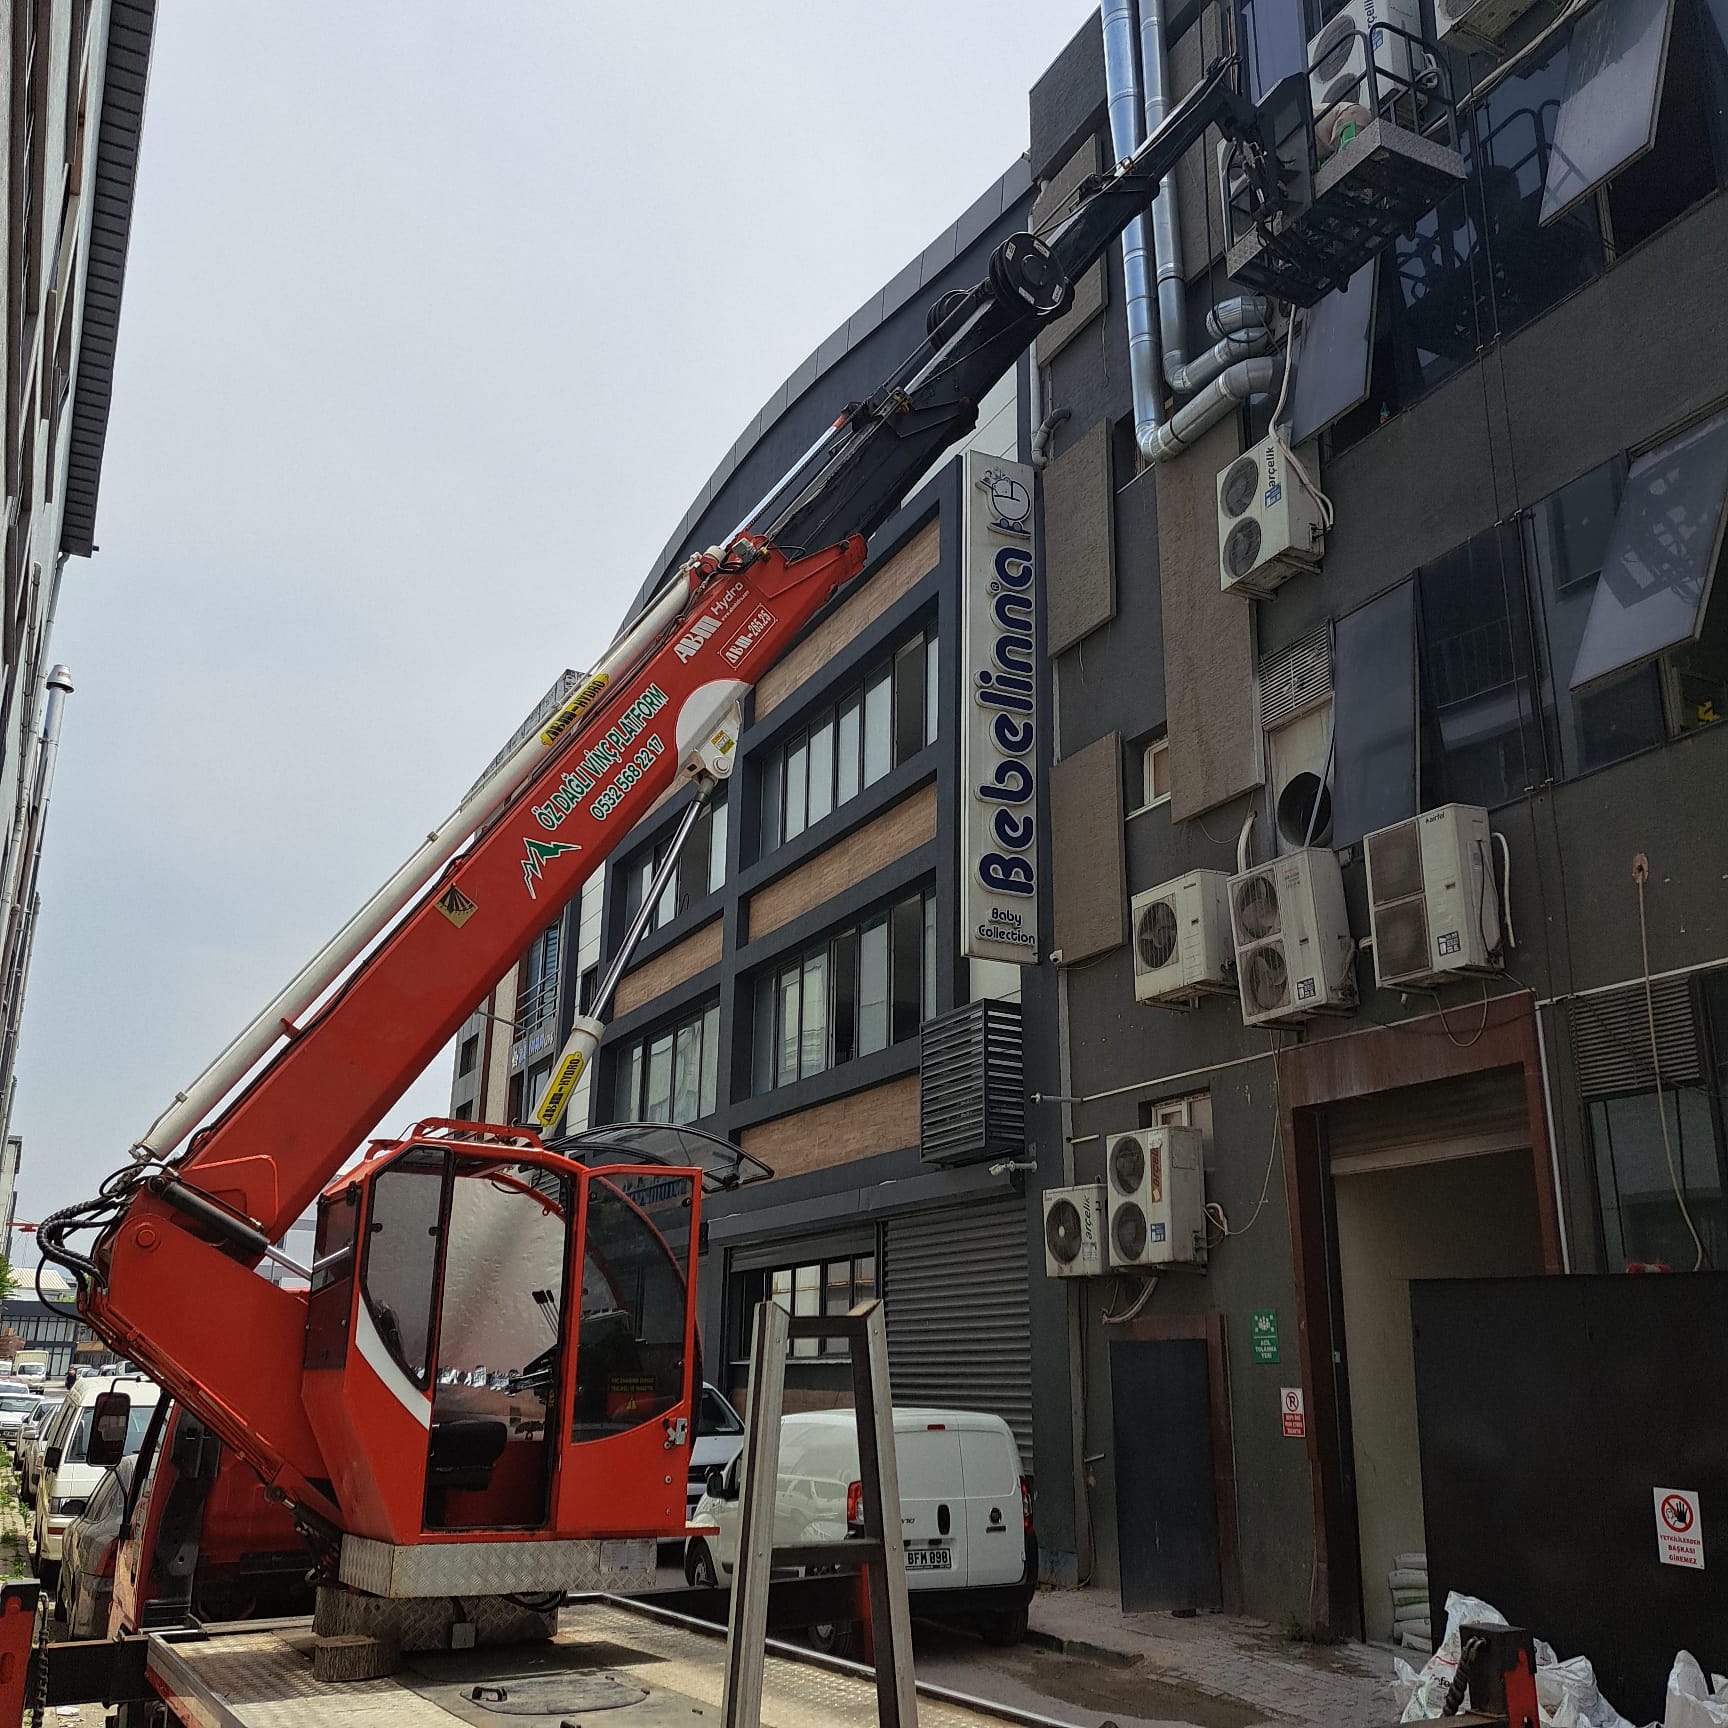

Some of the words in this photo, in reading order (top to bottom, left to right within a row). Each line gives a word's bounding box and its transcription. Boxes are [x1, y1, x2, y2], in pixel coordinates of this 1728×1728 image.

[1265, 446, 1278, 488] arçelik
[710, 582, 744, 615] Hydro
[673, 614, 722, 664] ABM
[976, 546, 1036, 897] Bebelinna
[531, 801, 567, 830] ÖZ
[551, 767, 595, 814] DAĞLI
[581, 740, 622, 778] VİNÇ
[605, 682, 670, 752] PLATFORM
[589, 785, 625, 821] 0532
[614, 764, 642, 792] 568
[633, 748, 656, 771] 22
[646, 733, 665, 755] 17
[978, 924, 1036, 945] Collection
[992, 907, 1022, 926] Baby
[543, 1058, 581, 1123] ABM-HYDRO
[1668, 1545, 1696, 1554] BAŞKASI
[1669, 1554, 1697, 1564] GİREMEZ
